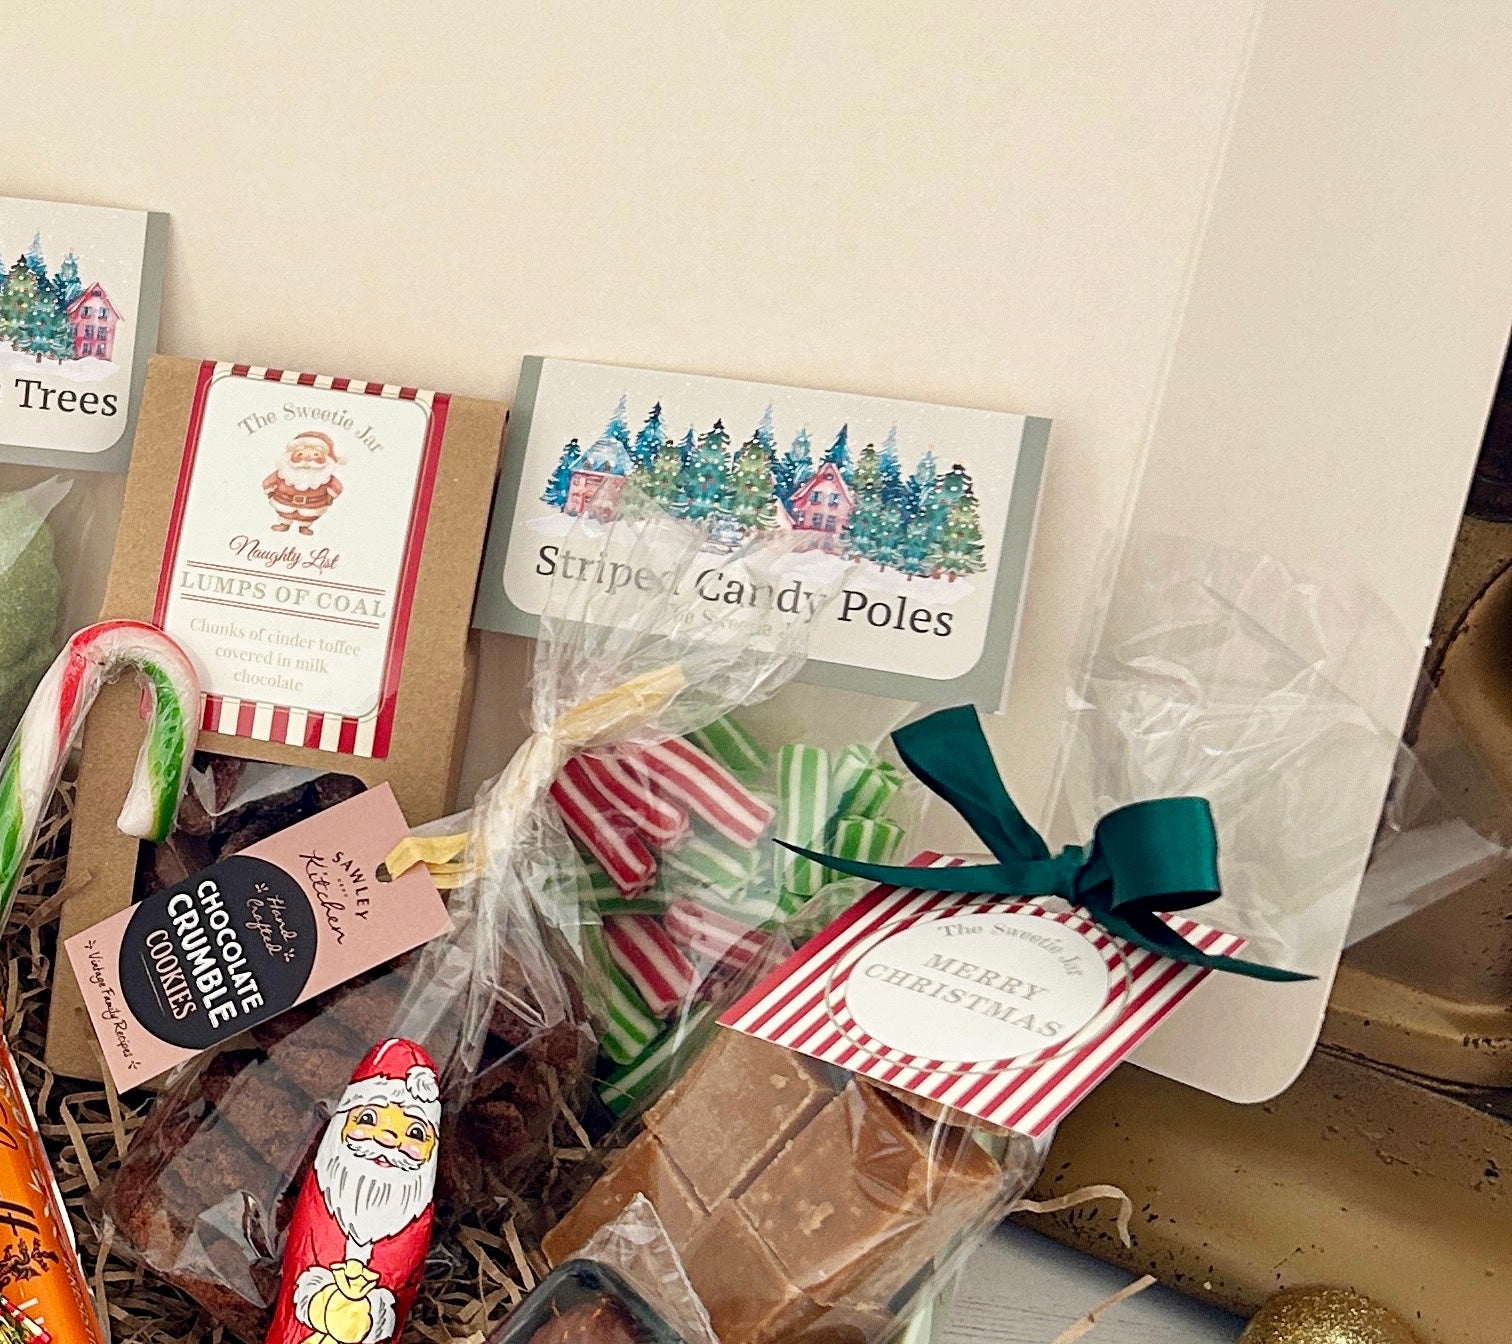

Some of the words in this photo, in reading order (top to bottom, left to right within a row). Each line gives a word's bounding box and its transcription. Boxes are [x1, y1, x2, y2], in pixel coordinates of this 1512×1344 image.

[15, 377, 119, 418] Trees
[237, 408, 278, 436] The
[282, 402, 355, 431] Sweetie
[355, 425, 384, 455] Jar
[228, 534, 302, 568] Naughty
[302, 548, 340, 575] List
[180, 571, 266, 600] LUMPS
[274, 585, 311, 605] OF
[316, 592, 387, 618] COAL
[837, 590, 955, 638] Poles
[189, 617, 246, 641] Chunks
[249, 626, 266, 641] of
[268, 629, 316, 651] cinder
[319, 636, 361, 657] toffee
[215, 645, 274, 666] covered
[277, 653, 292, 667] in
[295, 655, 329, 674] milk
[233, 669, 304, 693] chocolate
[299, 849, 346, 945] Kitchen
[332, 851, 370, 920] SAWLEY
[245, 898, 283, 957] Crafted
[267, 893, 298, 943] Hand
[167, 893, 238, 1030] CRUMBLE
[197, 880, 265, 1015] CHOCOLATE
[938, 923, 983, 937] The
[990, 922, 1064, 954] Sweetie
[1058, 955, 1085, 977] Jar
[145, 929, 197, 1021] COOKIES
[864, 963, 1063, 1038] CHRISTMAS
[921, 953, 1050, 1001] MERRY
[88, 951, 106, 988] Vintage
[101, 987, 121, 1020] Family
[114, 1019, 133, 1058] Recipes
